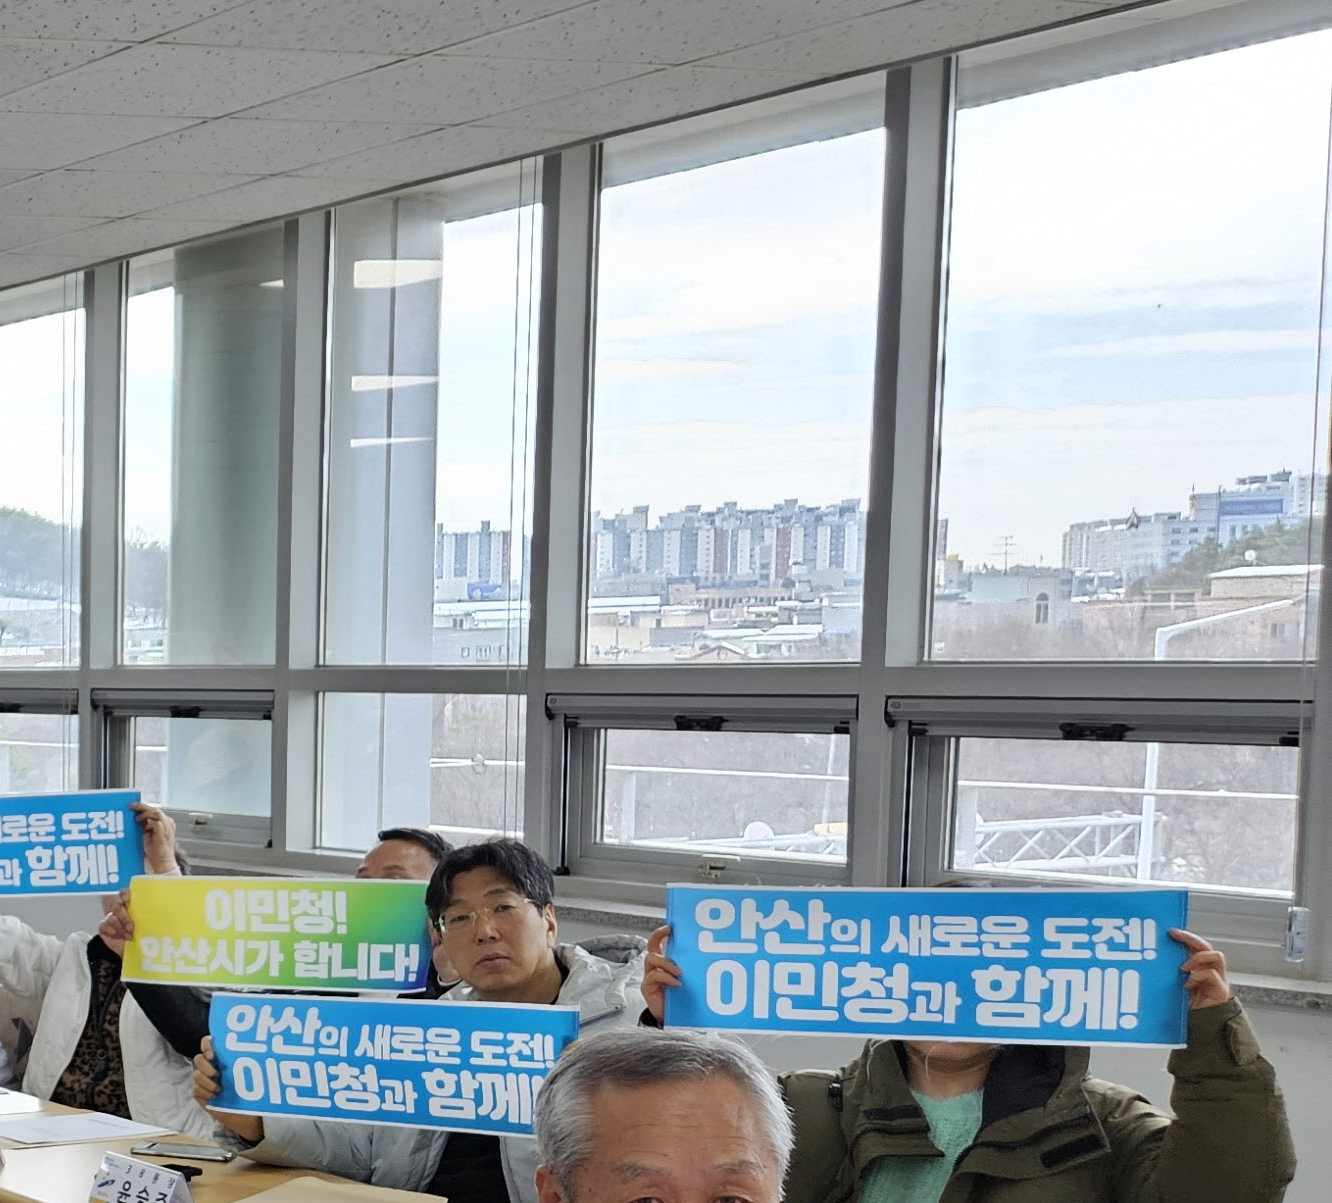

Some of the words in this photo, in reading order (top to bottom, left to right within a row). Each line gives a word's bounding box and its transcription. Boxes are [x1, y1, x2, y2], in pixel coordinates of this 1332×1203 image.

[61, 810, 125, 841] 도전!
[25, 844, 120, 887] 함께!
[204, 887, 347, 935] 이민청!
[694, 897, 872, 956] 안산의
[880, 915, 1033, 959] 새로운
[1040, 916, 1158, 962] 도전!
[139, 936, 283, 978] 안산시가
[292, 940, 420, 984] 합니다!
[705, 959, 963, 1025] 이민청과
[970, 964, 1140, 1031] 함께!
[225, 1003, 348, 1058] 안산의
[356, 1025, 462, 1066] 새로운
[469, 1030, 556, 1070] 도전!
[232, 1055, 418, 1114] 이민청과
